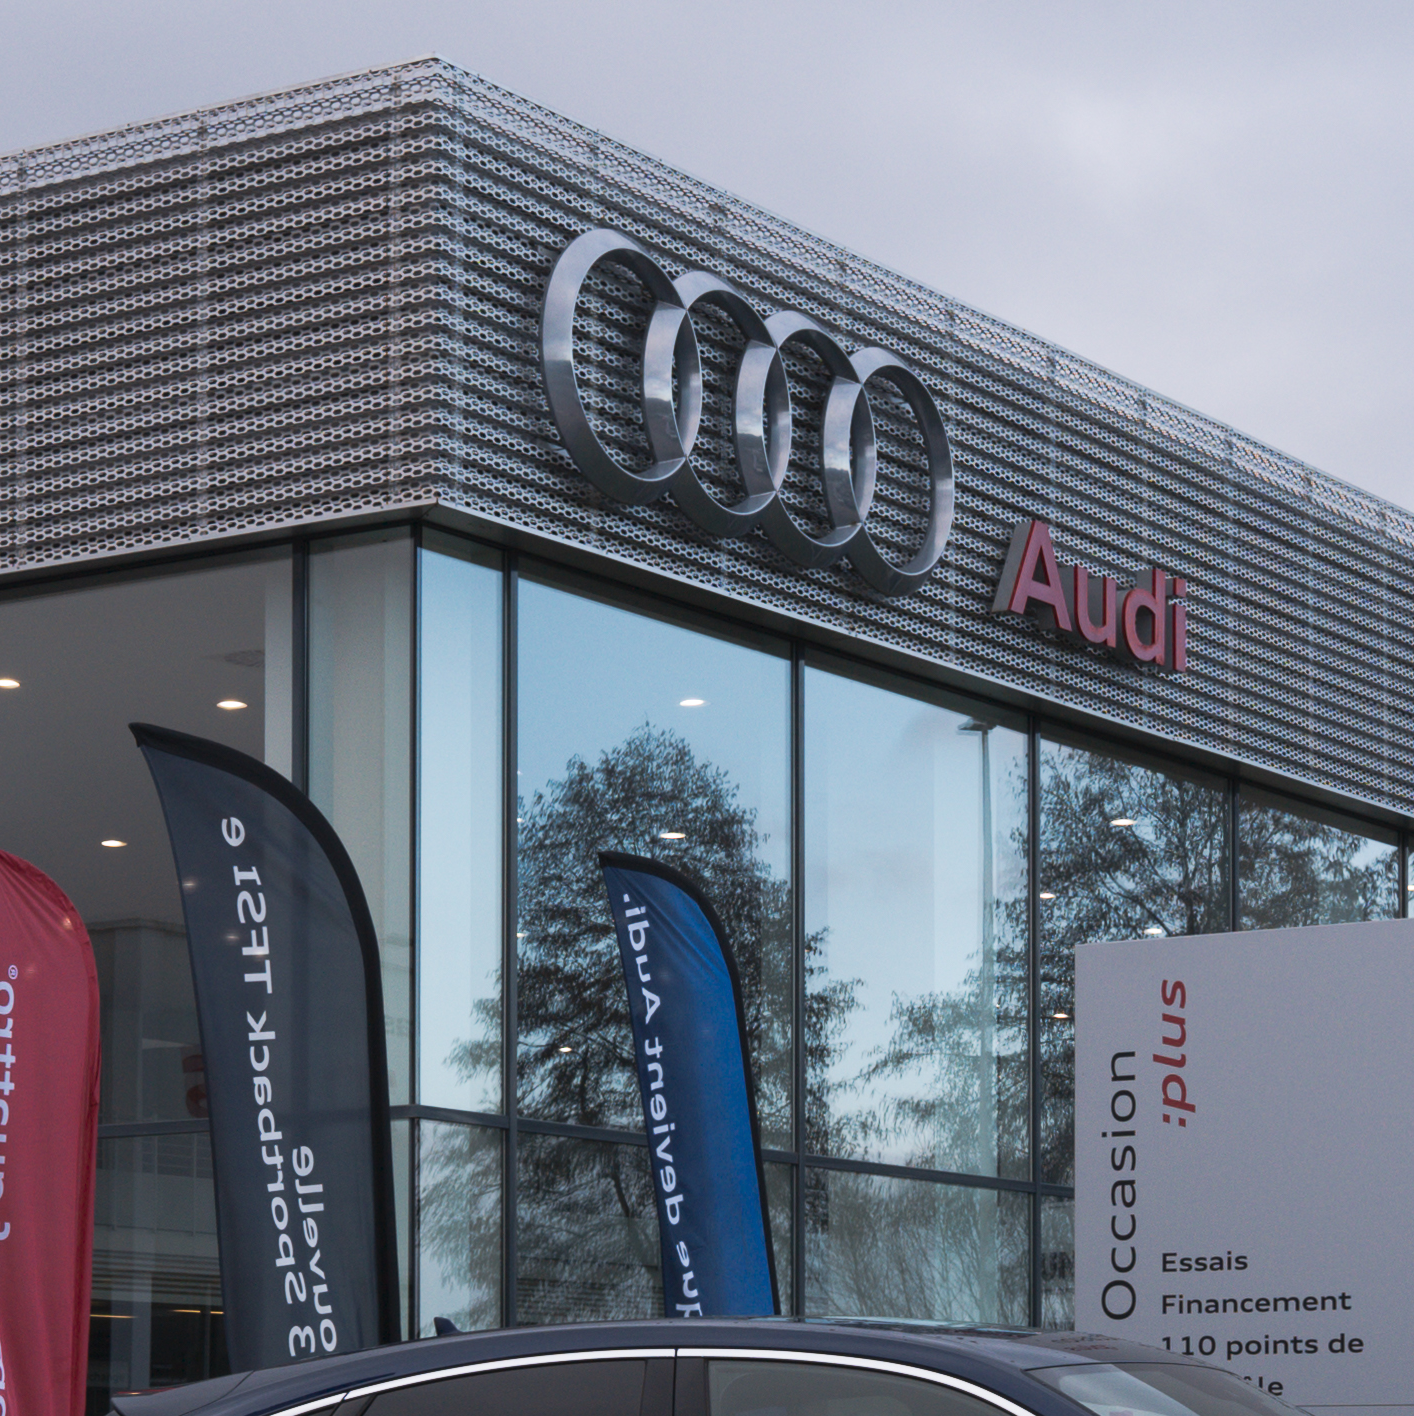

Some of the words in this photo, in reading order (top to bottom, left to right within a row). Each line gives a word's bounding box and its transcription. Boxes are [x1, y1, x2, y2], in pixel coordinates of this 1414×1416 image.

[995, 519, 1187, 672] Audi
[1101, 1049, 1137, 1321] Occasion
[1161, 1250, 1249, 1273] Essais
[1161, 1290, 1353, 1315] Financement
[1161, 1334, 1216, 1357] 110
[1226, 1334, 1319, 1361] points
[1328, 1333, 1365, 1354] de
